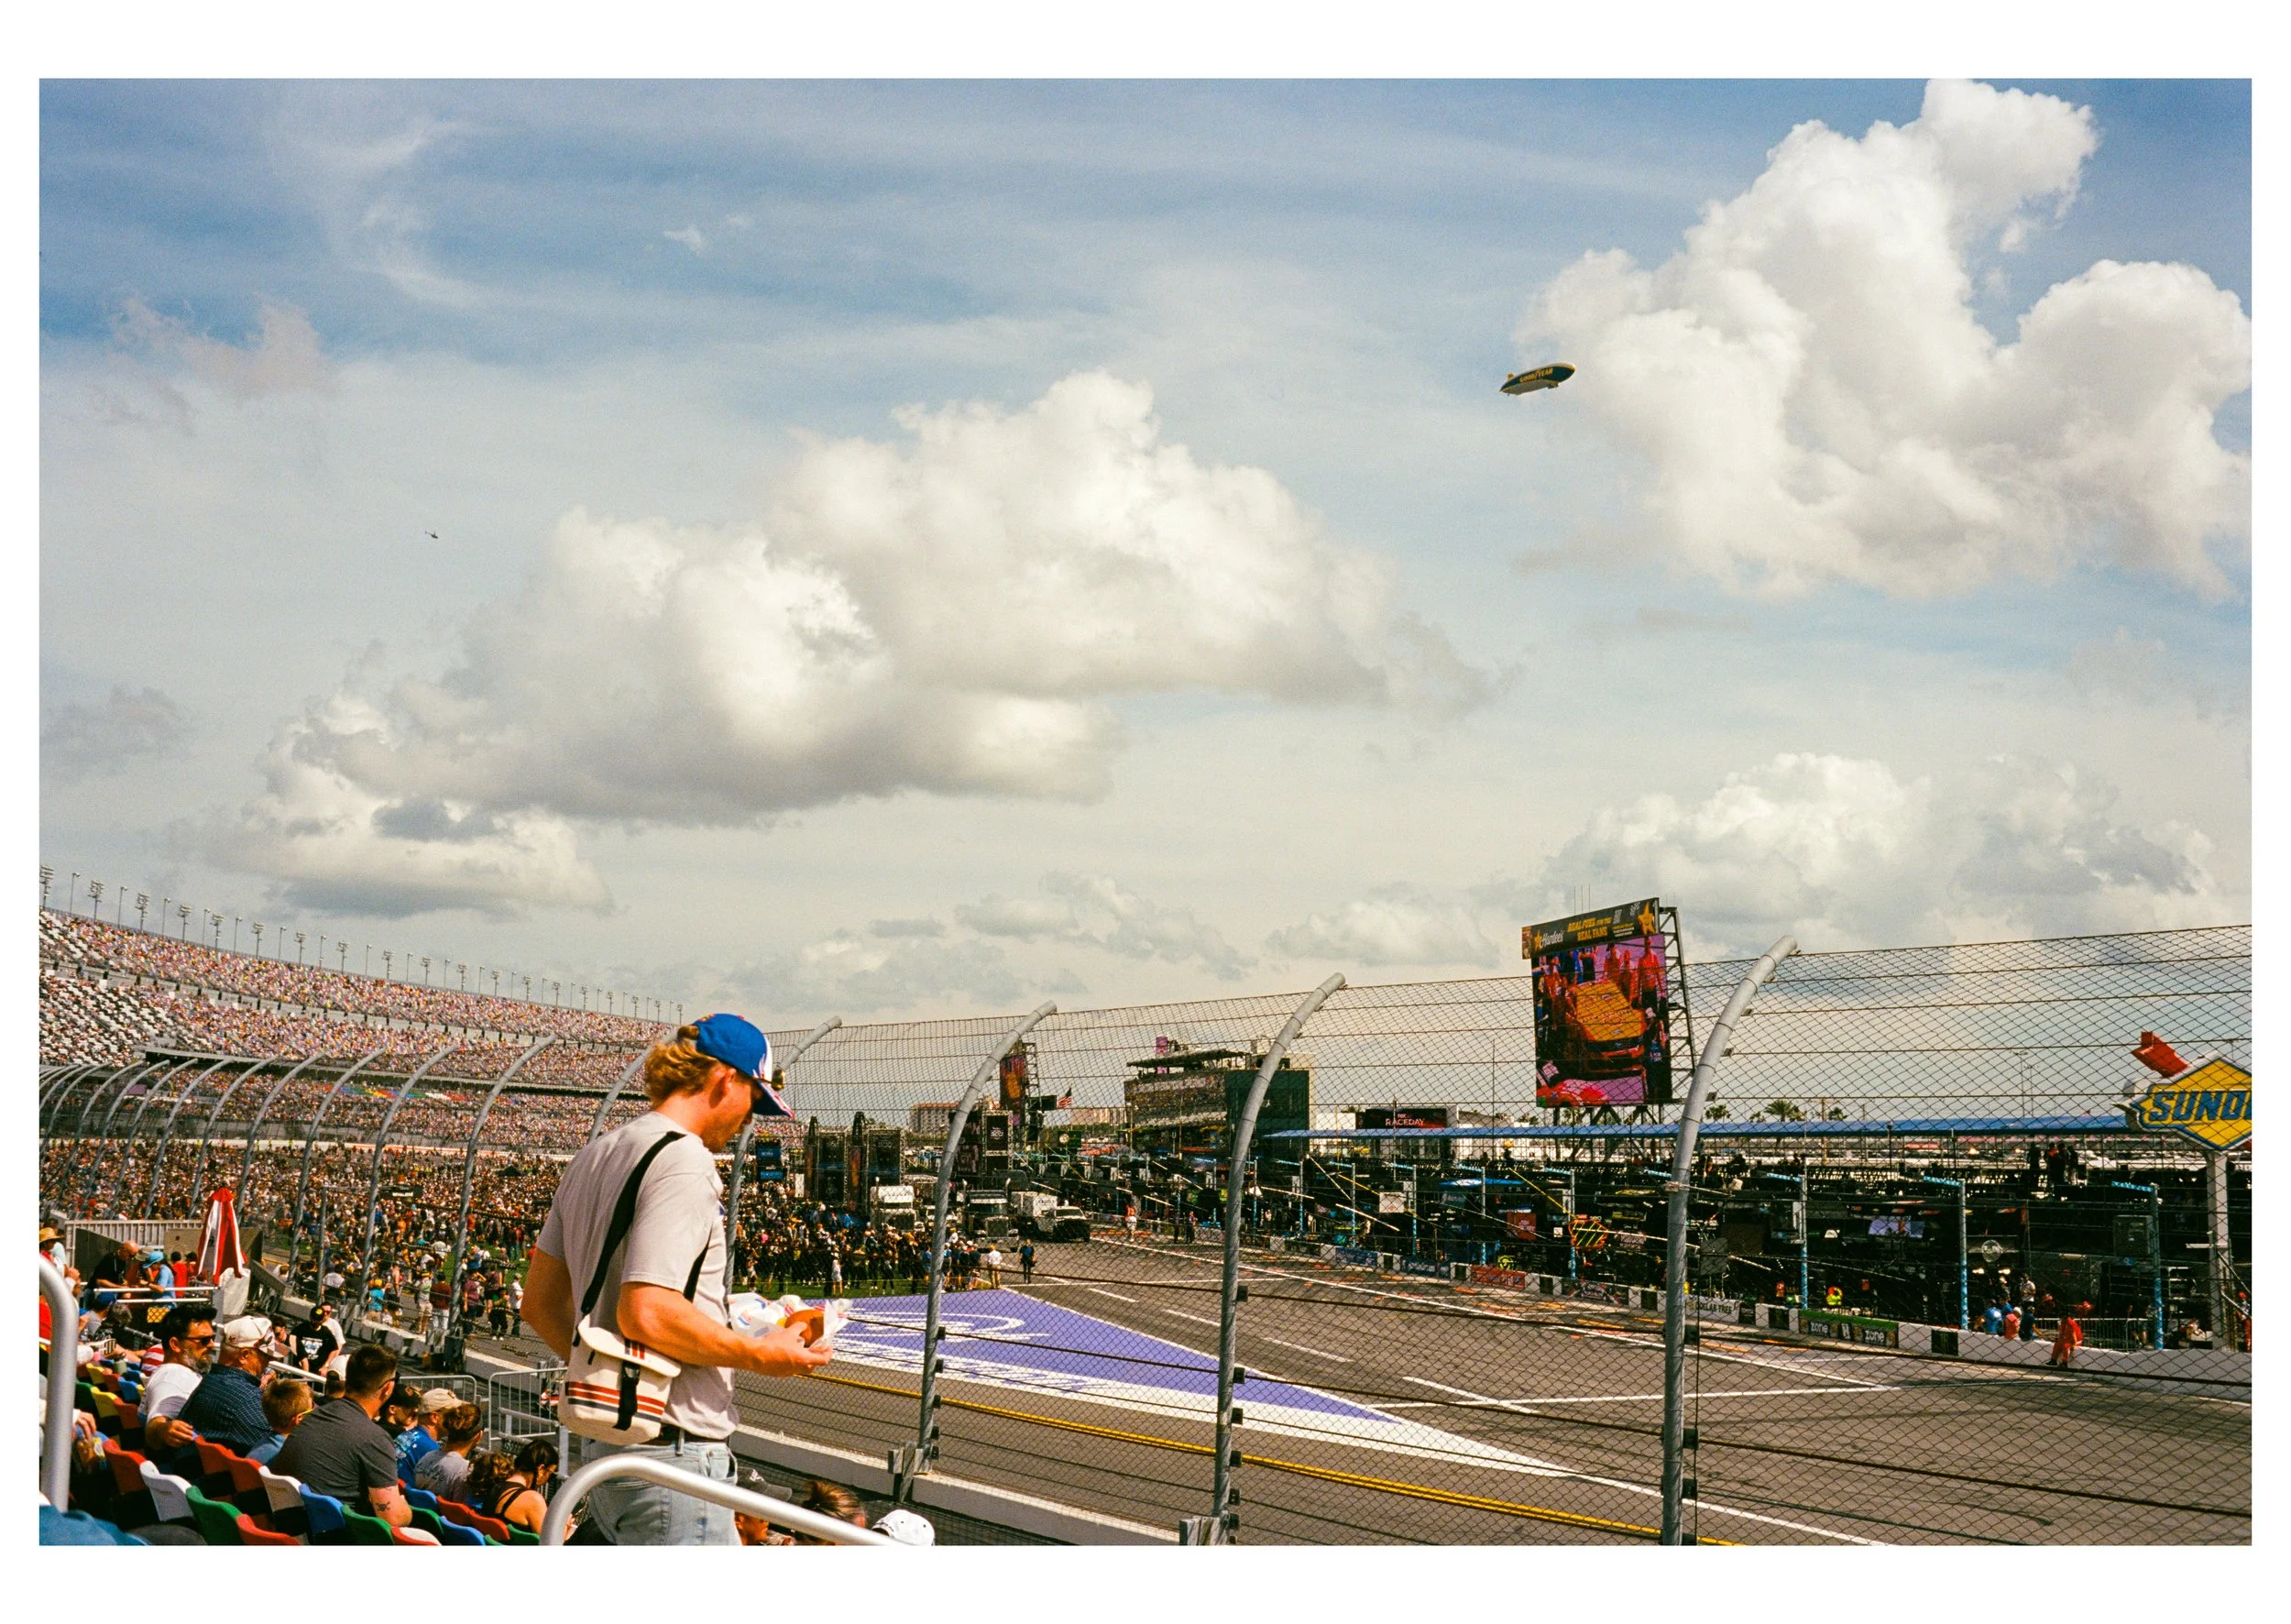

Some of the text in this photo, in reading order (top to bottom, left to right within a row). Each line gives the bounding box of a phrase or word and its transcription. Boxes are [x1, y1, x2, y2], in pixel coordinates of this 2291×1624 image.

[1385, 1118, 1424, 1126] RACEDAY
[1718, 1305, 1733, 1314] TREE
[1810, 1322, 1829, 1333] zone
[1864, 1330, 1885, 1343] zone
